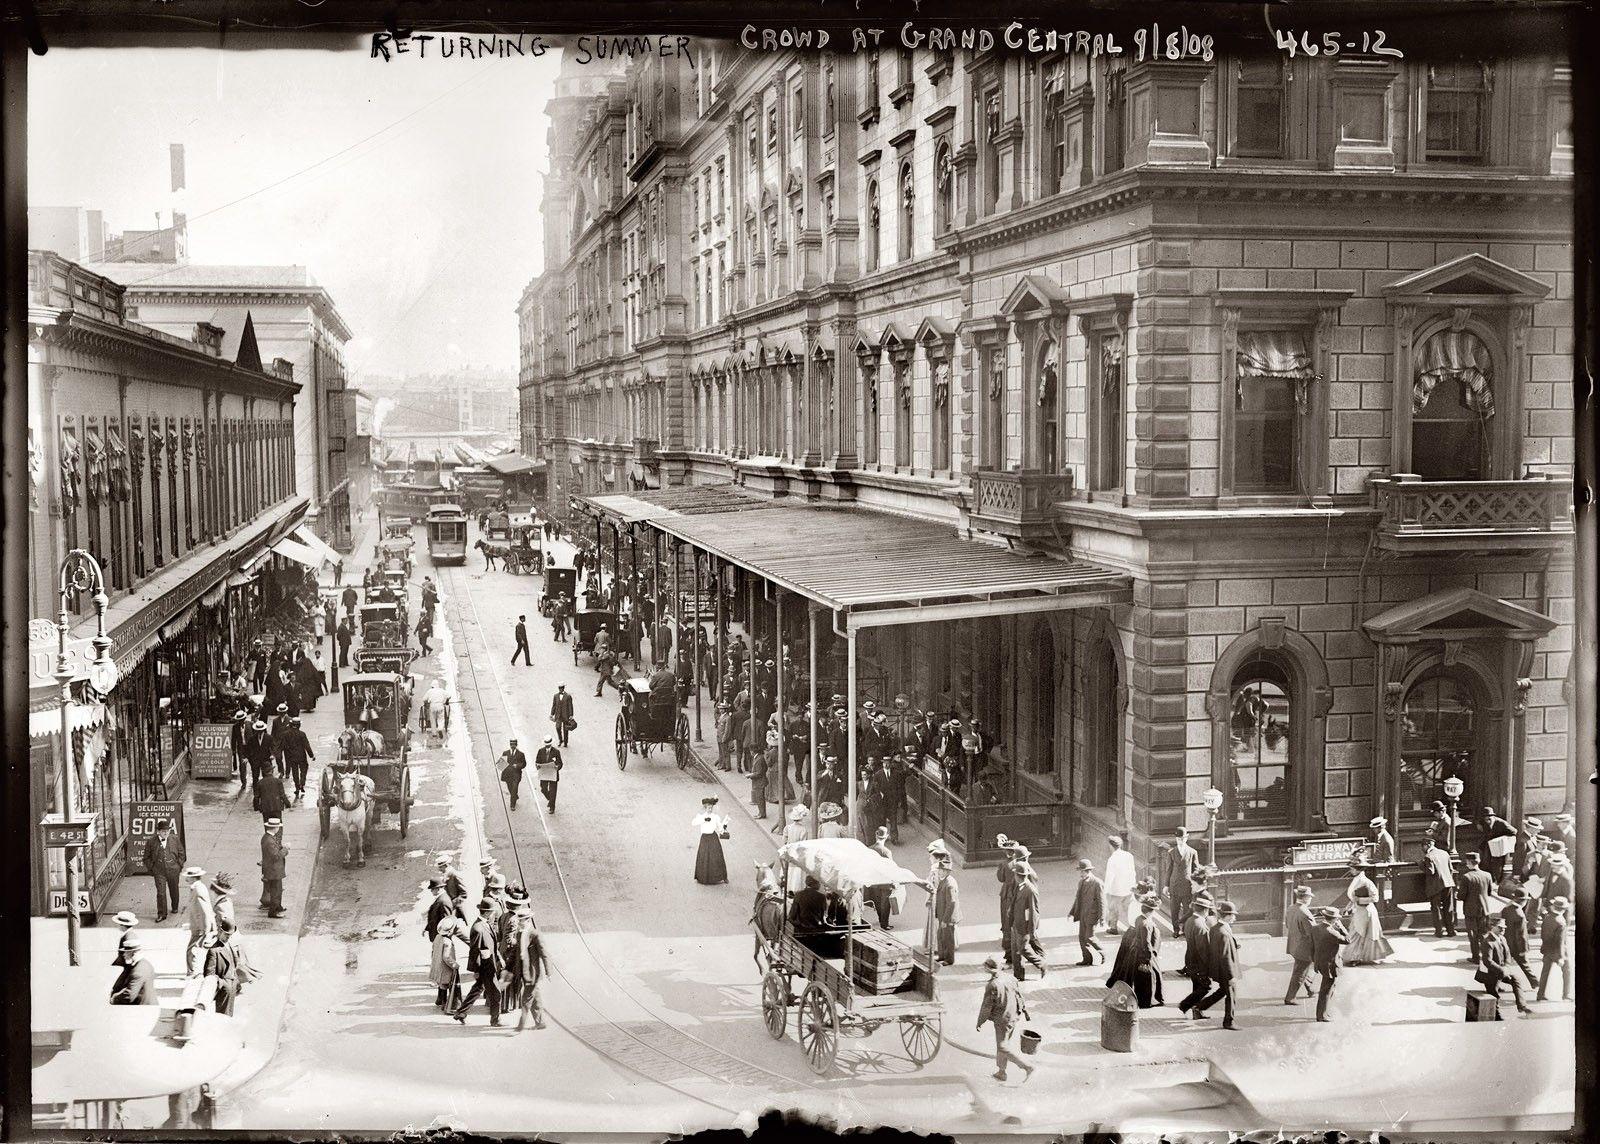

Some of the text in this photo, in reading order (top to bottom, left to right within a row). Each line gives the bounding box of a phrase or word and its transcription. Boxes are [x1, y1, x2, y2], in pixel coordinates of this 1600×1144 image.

[371, 30, 550, 62] RETURNING
[575, 34, 694, 69] SUMMER
[741, 24, 830, 51] CROWD
[852, 27, 885, 52] AT
[901, 21, 994, 51] GRAND
[1004, 21, 1123, 58] CENTRAL
[1276, 29, 1404, 58] 465-12
[196, 736, 231, 749] SODA
[132, 818, 178, 835] SOA
[60, 831, 74, 840] 42
[1310, 843, 1358, 854] SUBWAY
[1295, 851, 1352, 861] ENTRAN
